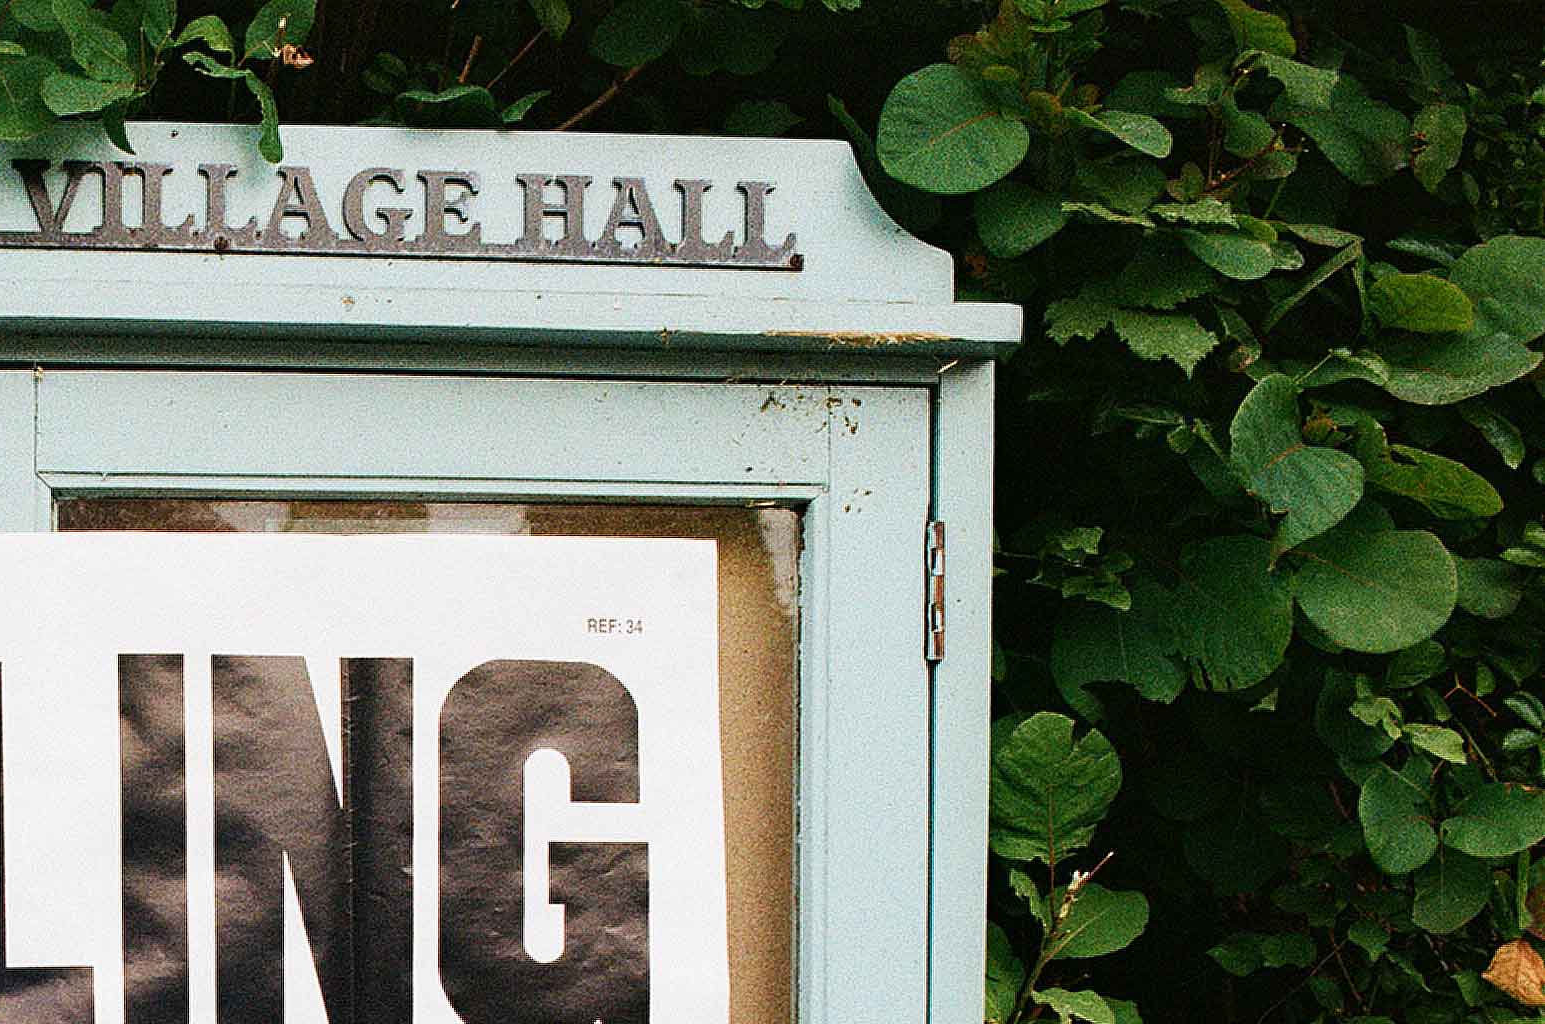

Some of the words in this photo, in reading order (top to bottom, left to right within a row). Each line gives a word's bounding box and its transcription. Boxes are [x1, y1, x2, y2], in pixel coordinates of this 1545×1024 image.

[8, 156, 482, 249] VILLAGE
[514, 172, 797, 262] HALL
[586, 617, 622, 634] REF:
[625, 618, 644, 634] 34
